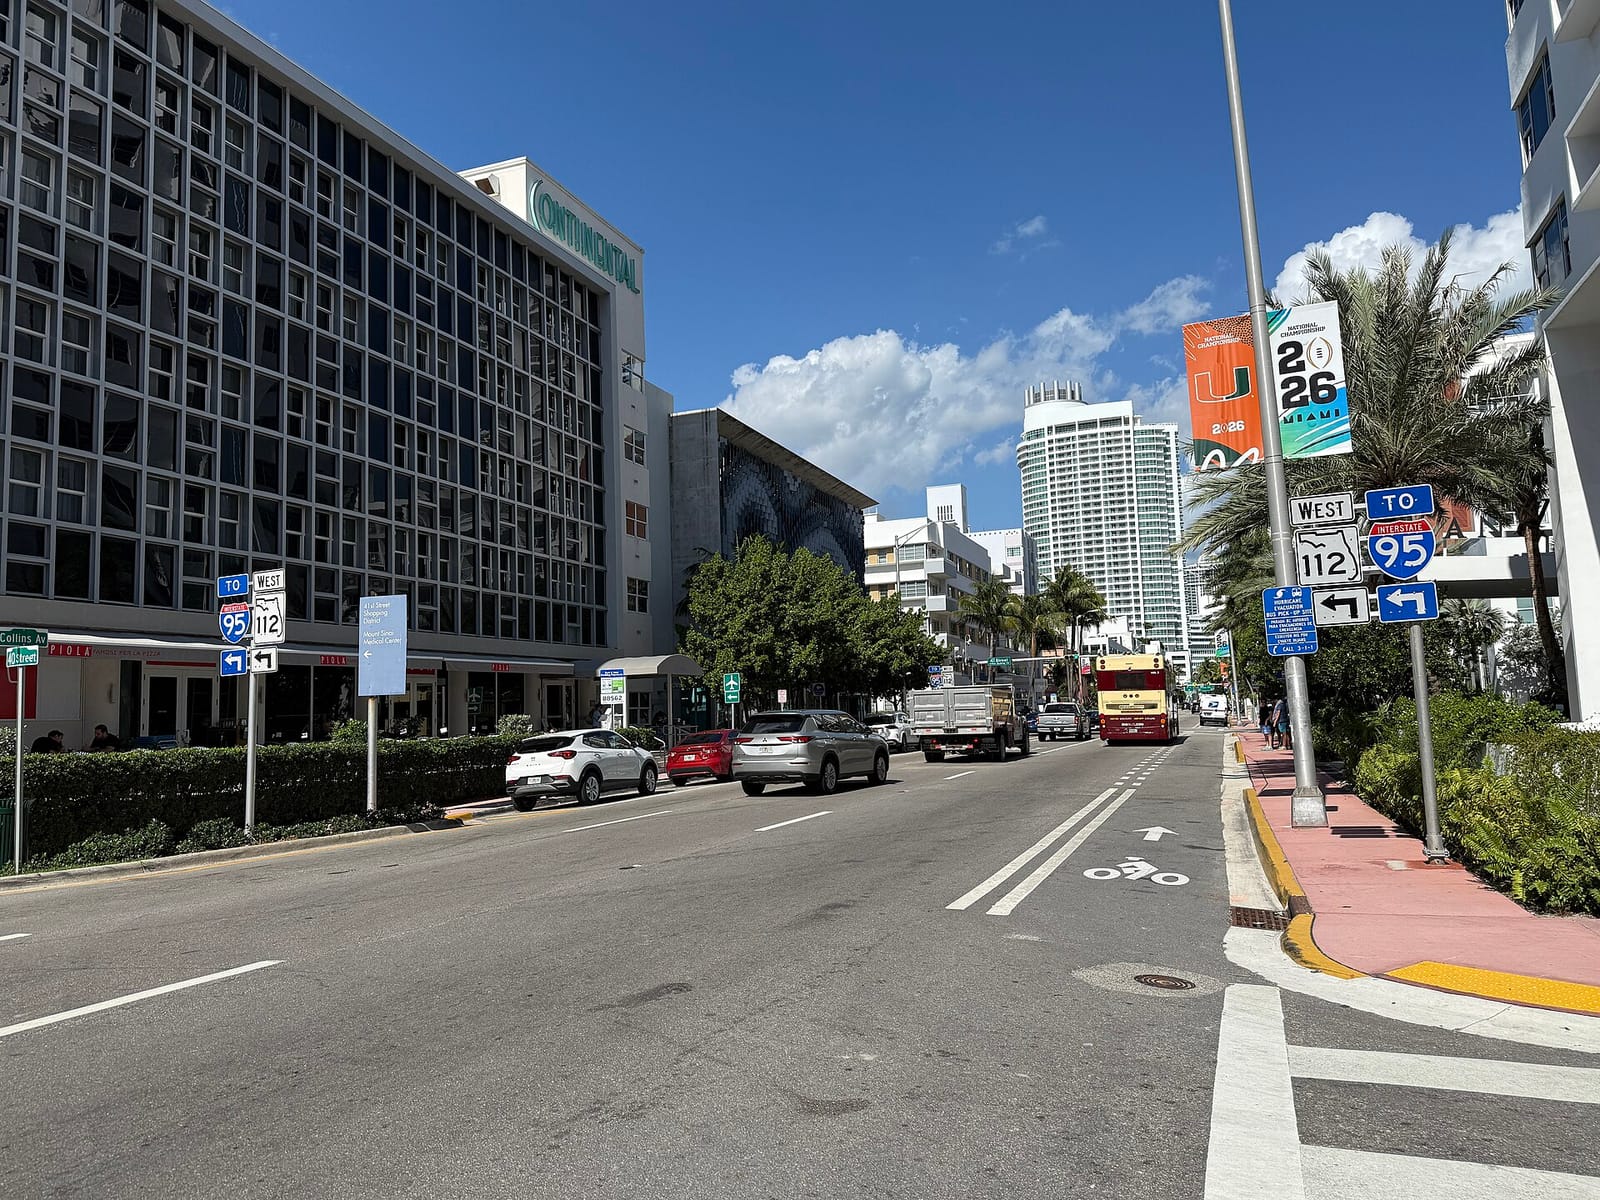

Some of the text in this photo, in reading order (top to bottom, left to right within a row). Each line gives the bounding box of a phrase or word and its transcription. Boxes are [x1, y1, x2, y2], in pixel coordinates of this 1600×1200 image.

[529, 179, 640, 294] CONTINENTAL
[1280, 326, 1326, 338] CHAMPIONSHIP
[1287, 322, 1318, 332] NATIONAL
[1197, 337, 1240, 349] CHAMPIONSHIP
[1204, 333, 1233, 343] NATIONAL
[1194, 366, 1252, 403] U
[1280, 371, 1338, 409] 26
[1283, 409, 1340, 424] MIAMI
[1382, 493, 1414, 512] TO
[1298, 500, 1344, 520] WEST
[1377, 522, 1423, 534] INTERSTATE
[1375, 535, 1427, 568] 95
[1302, 552, 1346, 577] 112
[225, 579, 240, 592] TO
[257, 575, 280, 588] WEST
[363, 609, 388, 618] Shopping
[223, 613, 245, 636] 95
[256, 615, 279, 634] 112
[0, 632, 46, 643] Collins Av
[50, 645, 90, 657] PIOLA
[321, 656, 346, 665] PIOLA
